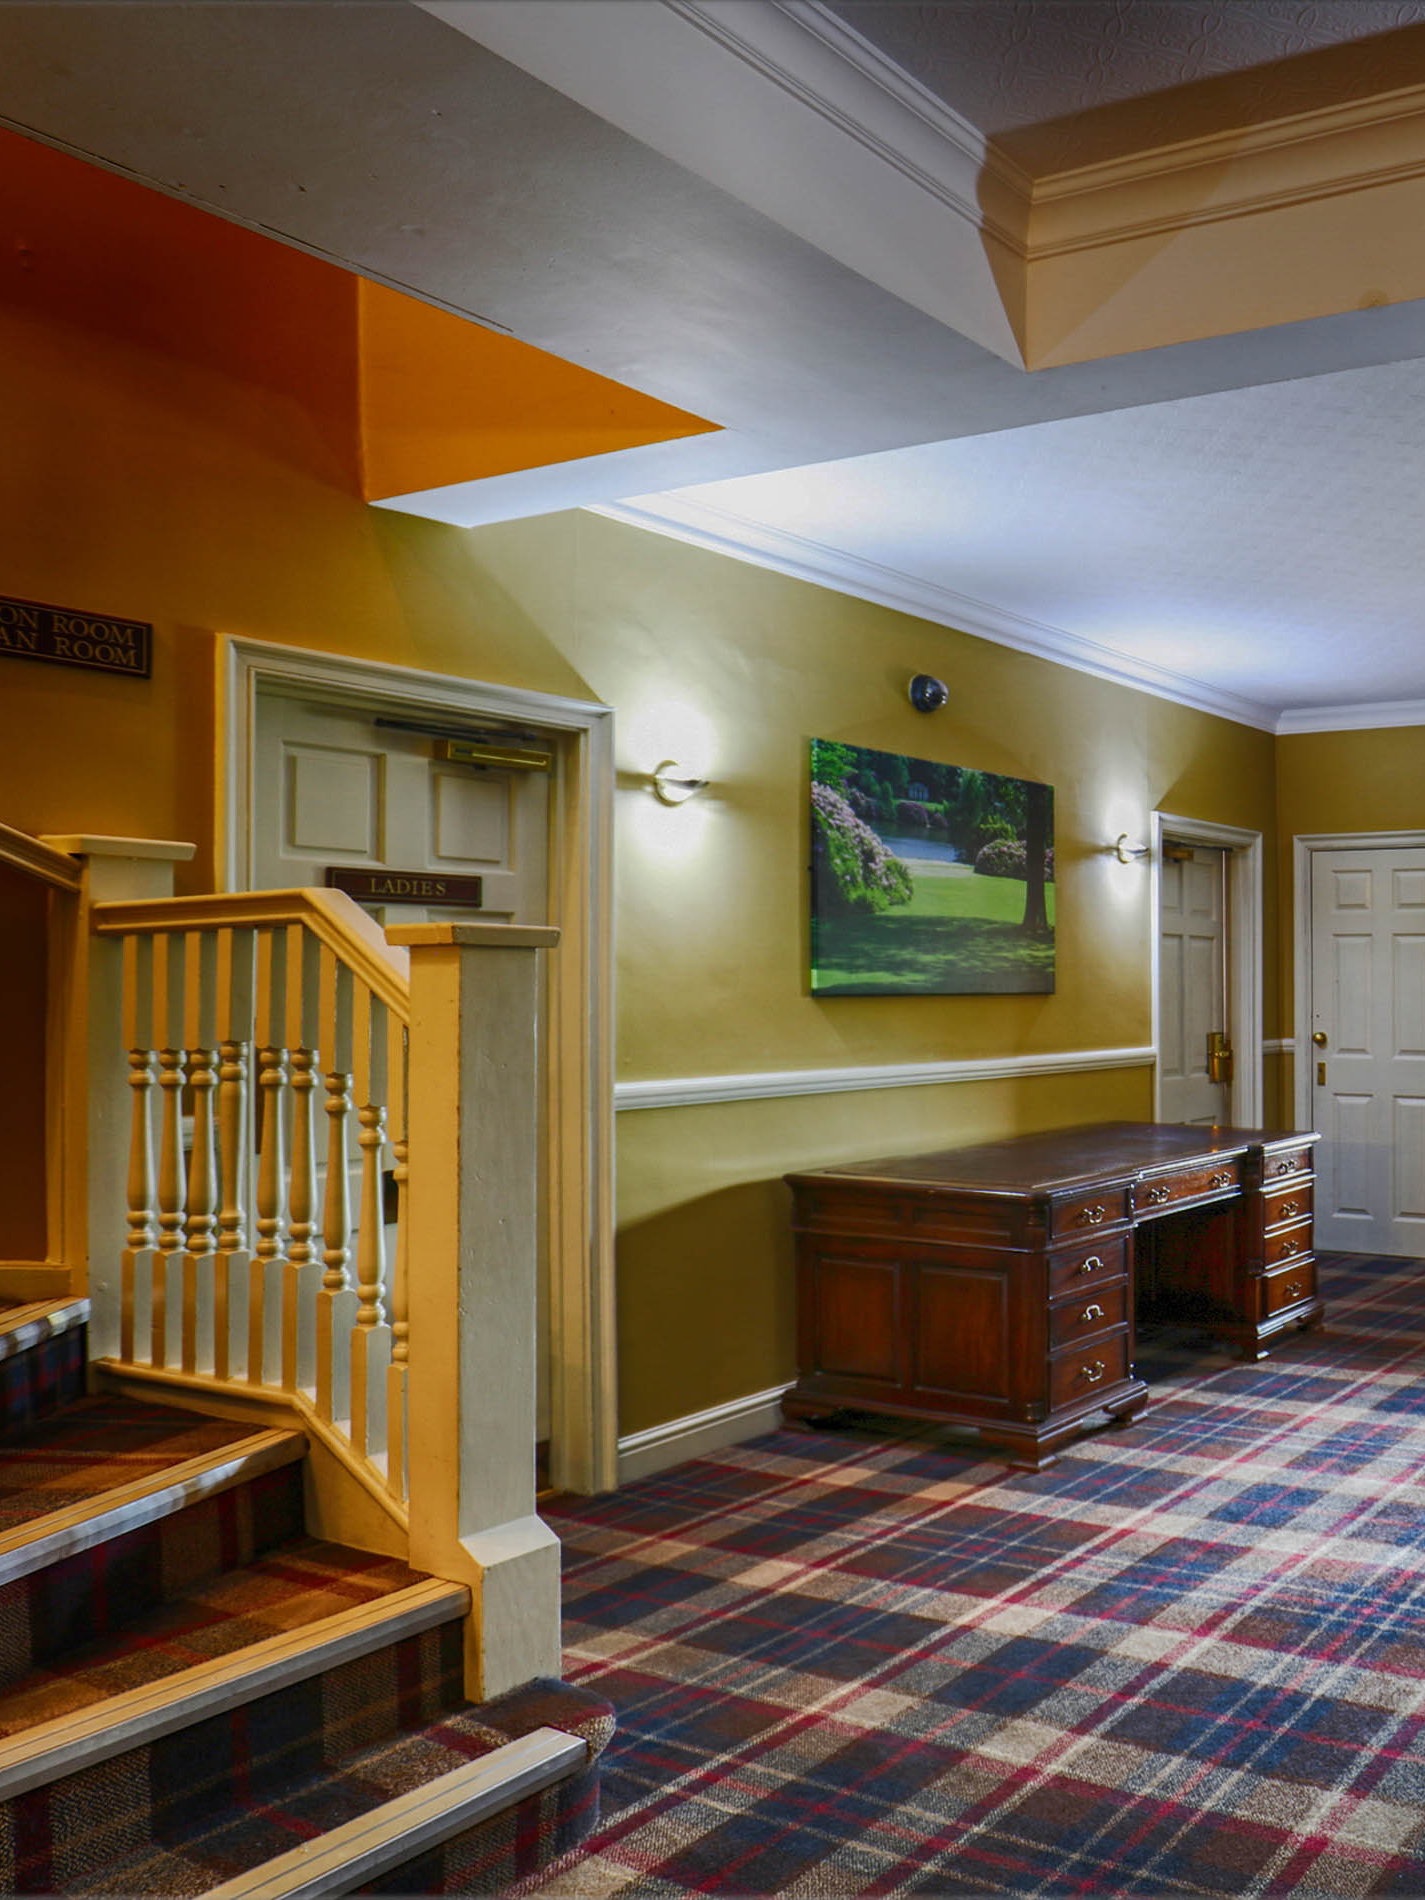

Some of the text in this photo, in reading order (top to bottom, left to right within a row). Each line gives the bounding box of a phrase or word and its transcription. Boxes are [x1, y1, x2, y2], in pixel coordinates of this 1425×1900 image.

[52, 615, 136, 647] ROOM
[53, 635, 138, 667] ROOM
[370, 877, 447, 897] LADIES
